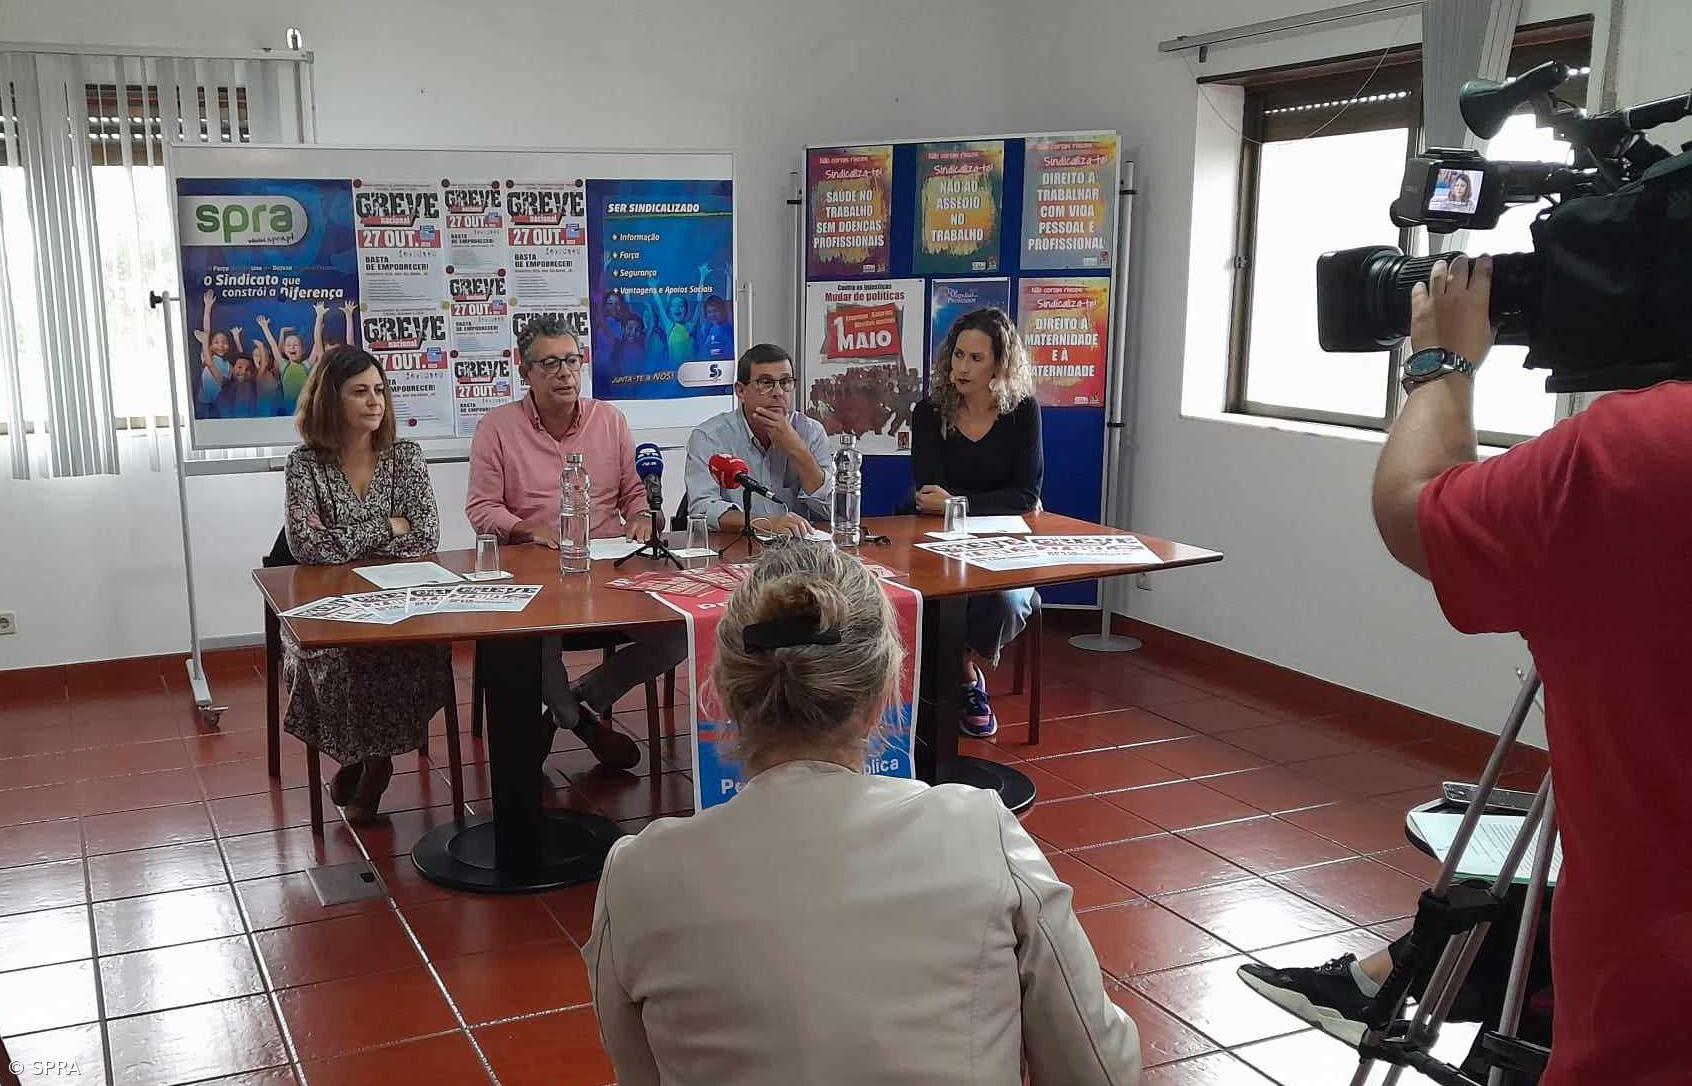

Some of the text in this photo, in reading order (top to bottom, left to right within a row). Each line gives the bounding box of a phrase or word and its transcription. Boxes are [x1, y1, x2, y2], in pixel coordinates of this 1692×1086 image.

[1042, 172, 1084, 184] DIREITO
[444, 190, 502, 208] GREVE
[860, 190, 872, 201] NO
[1037, 189, 1100, 202] TRABALHAR
[356, 192, 440, 218] GREVE
[507, 191, 584, 217] GREVE
[608, 204, 700, 212] SER SINDICALIZADO
[826, 205, 873, 218] TRABALHO
[1040, 204, 1094, 218] COM VIDA
[196, 204, 293, 243] spra
[450, 216, 488, 228] 27 OUT.
[951, 214, 965, 225] NO
[816, 222, 836, 234] SEM
[1039, 222, 1094, 234] PESSOAL E
[363, 230, 419, 248] 27 OUT.
[514, 229, 565, 245] 27 OUT.
[620, 233, 660, 242] Informação
[814, 234, 884, 248] PROFISSIONAIS
[932, 228, 984, 242] TRABALHO
[1028, 238, 1104, 250] PROFISSIONAL
[216, 273, 278, 286] Sindicato
[282, 277, 300, 287] que
[222, 287, 266, 297] constrói
[269, 289, 276, 297] a
[450, 278, 506, 296] GREVE
[826, 292, 852, 302] Mudar
[854, 292, 865, 300] de
[454, 304, 492, 316] 27 OUT.
[364, 316, 446, 342] GREVE
[1036, 318, 1078, 330] DIREITO
[838, 330, 892, 352] MAIO
[1025, 333, 1098, 346] MATERNIDADE
[392, 352, 426, 370] OUT.
[1052, 348, 1068, 361] E À
[454, 360, 510, 378] GREVE
[1030, 365, 1096, 377] ATERNIDADE
[390, 384, 436, 392] MPOBRECER!
[459, 386, 496, 398] 27 OUT.
